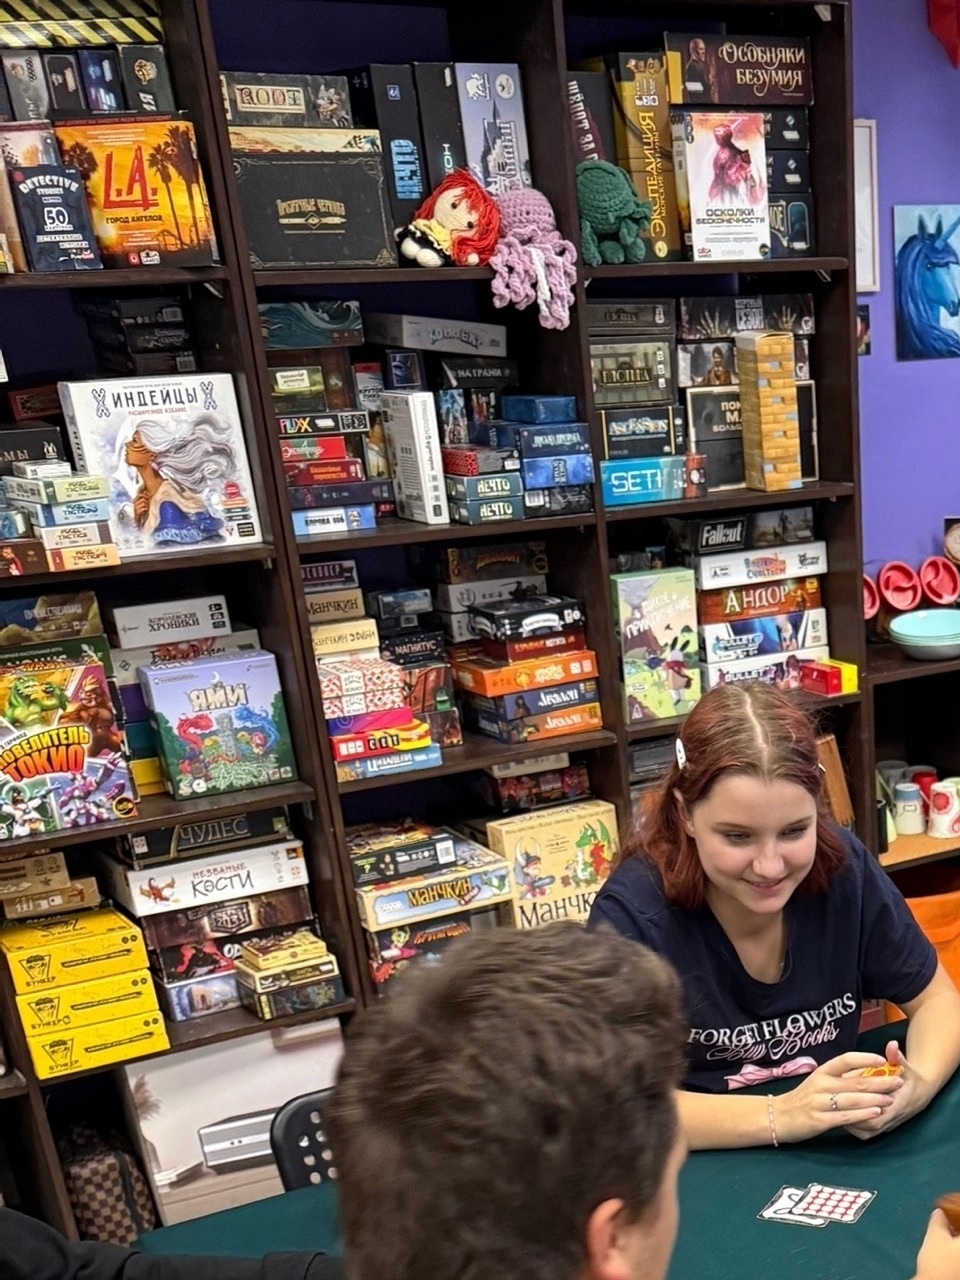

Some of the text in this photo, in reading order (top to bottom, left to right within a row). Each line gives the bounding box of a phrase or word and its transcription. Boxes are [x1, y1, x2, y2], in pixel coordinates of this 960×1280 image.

[718, 41, 806, 69] ОСОБНЯКИ
[735, 68, 803, 96] БЕЗУМИЯ
[238, 86, 302, 107] ROOT
[18, 175, 79, 194] DETECTIVE
[638, 112, 667, 238] ЭКСПЕДИЦИЯ
[44, 207, 69, 226] 50
[106, 214, 163, 224] ГОРОД АНГЕЛОВ
[706, 208, 755, 218] ОСКОЛКИ
[111, 387, 199, 409] ИНДЕЙЦЫ
[477, 479, 511, 494] НЕЧТО
[610, 468, 662, 493] SETI
[479, 502, 513, 518] НЕЧТО
[702, 522, 742, 546] Fallout
[725, 585, 789, 614] АНДОР
[149, 618, 200, 632] ХРОНИКИ
[2, 744, 85, 783] ТОКИО
[179, 817, 249, 845] ЧУДЕС
[192, 862, 247, 879] НЕЗВАНЫЕ
[191, 870, 255, 899] КОСТИ
[518, 891, 599, 930] Манчк
[25, 976, 56, 987] БУНКЕР
[31, 1018, 62, 1030] БУНКЕР
[688, 993, 857, 1045] FORGET FLOWERS
[768, 1020, 839, 1058] Books
